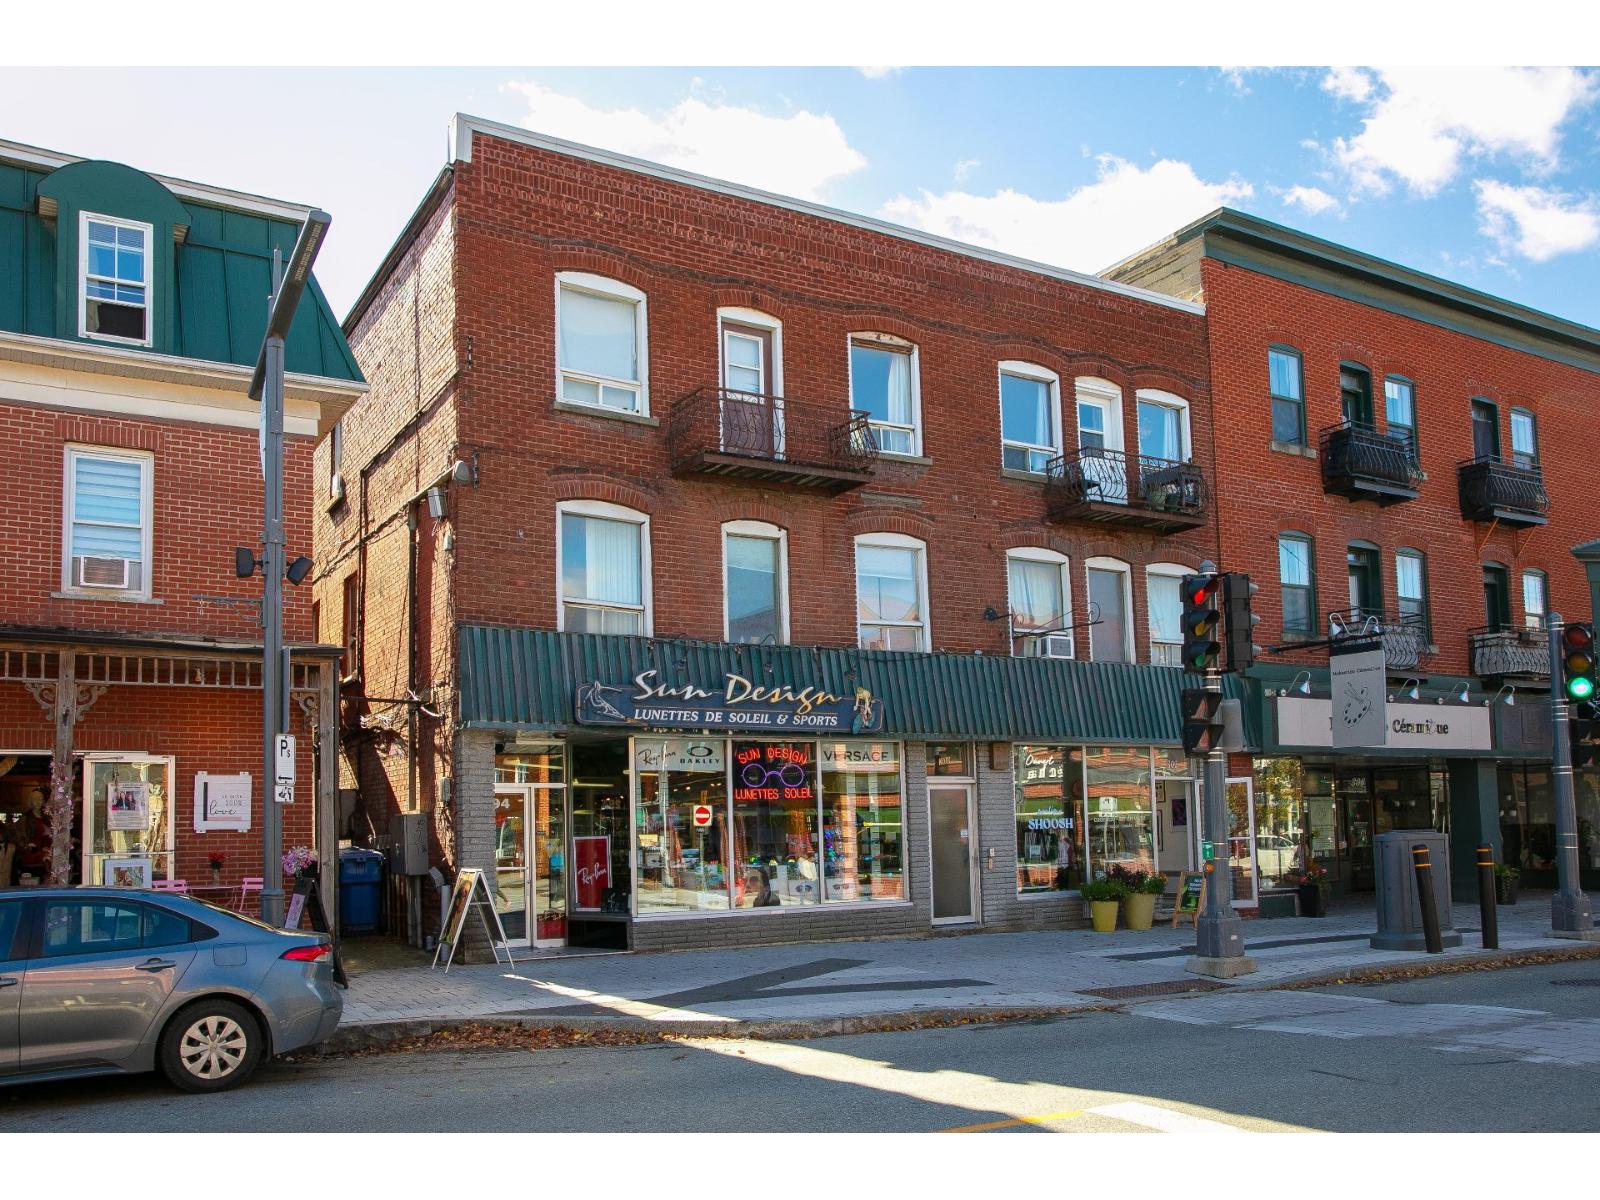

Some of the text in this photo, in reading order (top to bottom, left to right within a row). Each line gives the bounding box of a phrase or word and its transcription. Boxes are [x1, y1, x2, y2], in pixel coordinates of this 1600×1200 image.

[633, 670, 842, 715] Sun Design
[634, 709, 838, 726] LUNETTES DE SOLEIL & SPORTS
[738, 747, 808, 766] SUN DESIGN
[823, 751, 889, 762] VERSACE
[735, 787, 813, 800] LUNETTES SOLEIL
[1028, 817, 1074, 830] SHOOSH
